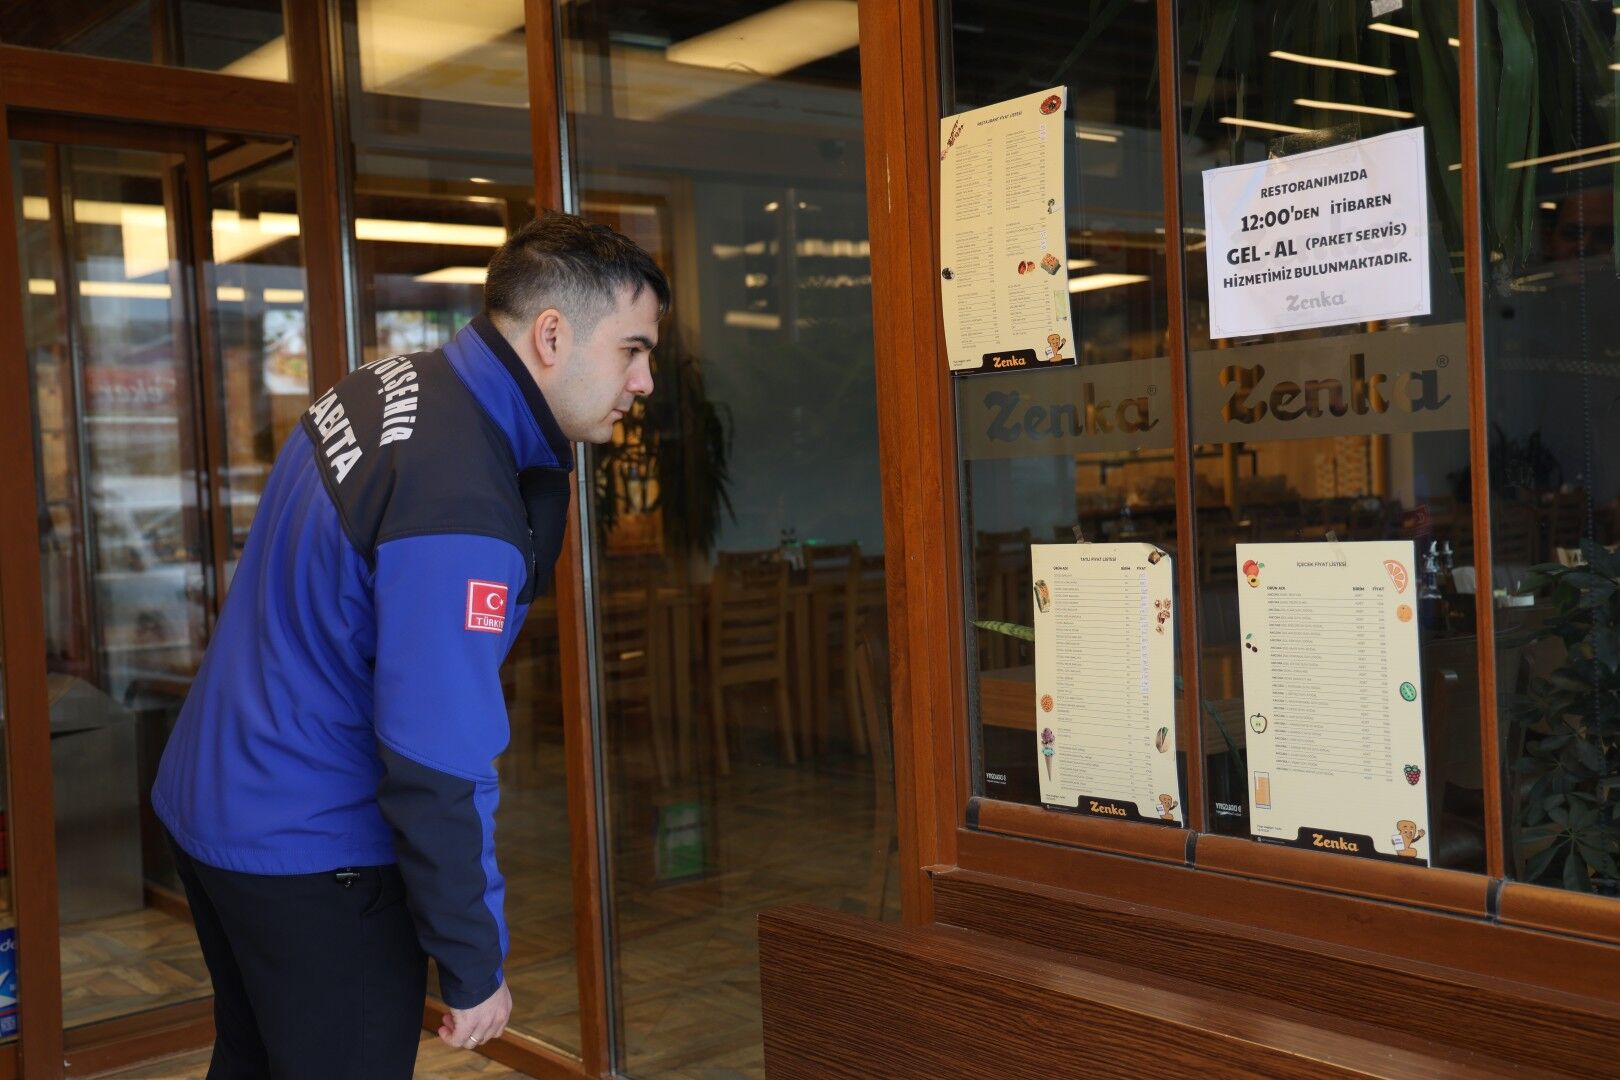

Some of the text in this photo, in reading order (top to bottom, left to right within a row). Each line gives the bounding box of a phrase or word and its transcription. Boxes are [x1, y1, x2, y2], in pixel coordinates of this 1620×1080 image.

[1260, 168, 1368, 199] RESTORANIMIZDA
[1241, 193, 1392, 233] 12:00'DEN İTİBAREN
[1226, 245, 1260, 266] GEL
[1274, 239, 1297, 259] AL
[1305, 231, 1353, 251] (PAKET
[1355, 222, 1408, 242] SERVİS)
[1223, 251, 1412, 289] HİZMETİMİZ BULUNMAKTADIR.
[1286, 291, 1346, 312] Zenka
[993, 355, 1027, 369] Zenka
[1219, 352, 1451, 425] Zenka
[1089, 800, 1127, 817] Zenka
[1312, 833, 1360, 853] Zenka
